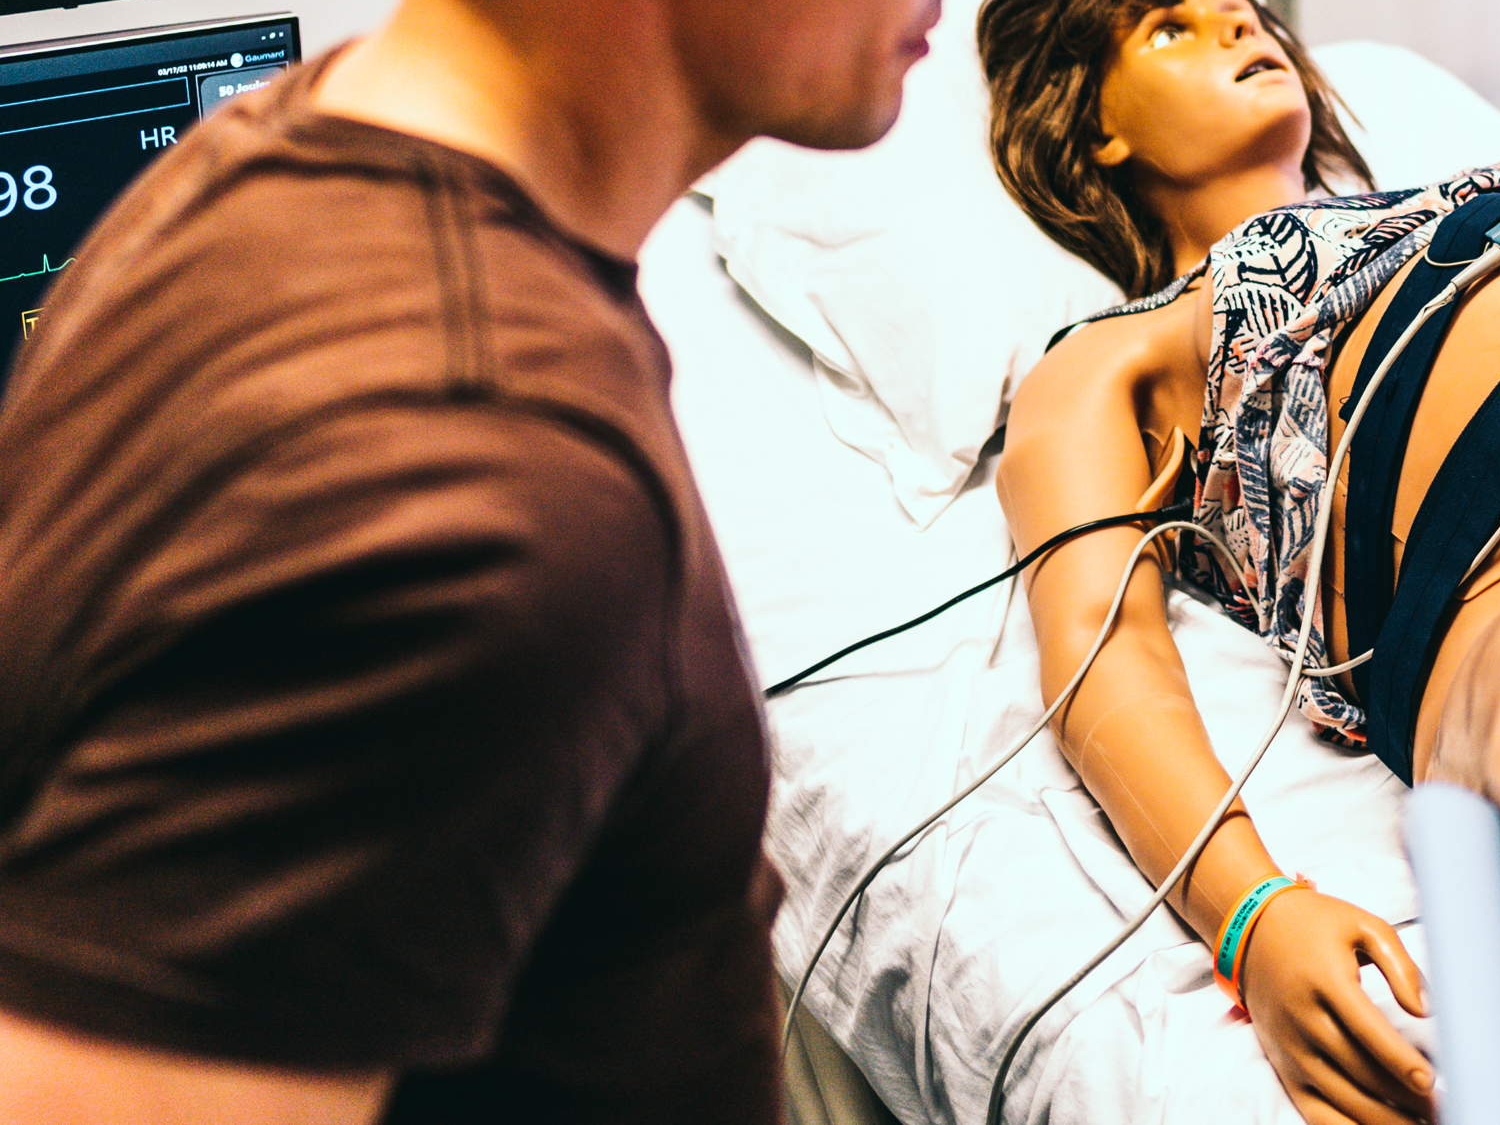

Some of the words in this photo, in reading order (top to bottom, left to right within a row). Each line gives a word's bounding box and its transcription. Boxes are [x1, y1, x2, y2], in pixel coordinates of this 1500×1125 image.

[245, 50, 285, 63] Gaumard
[218, 84, 234, 98] 50
[235, 79, 270, 94] Joule
[140, 126, 178, 151] HR
[1231, 898, 1254, 930] VICTORIA
